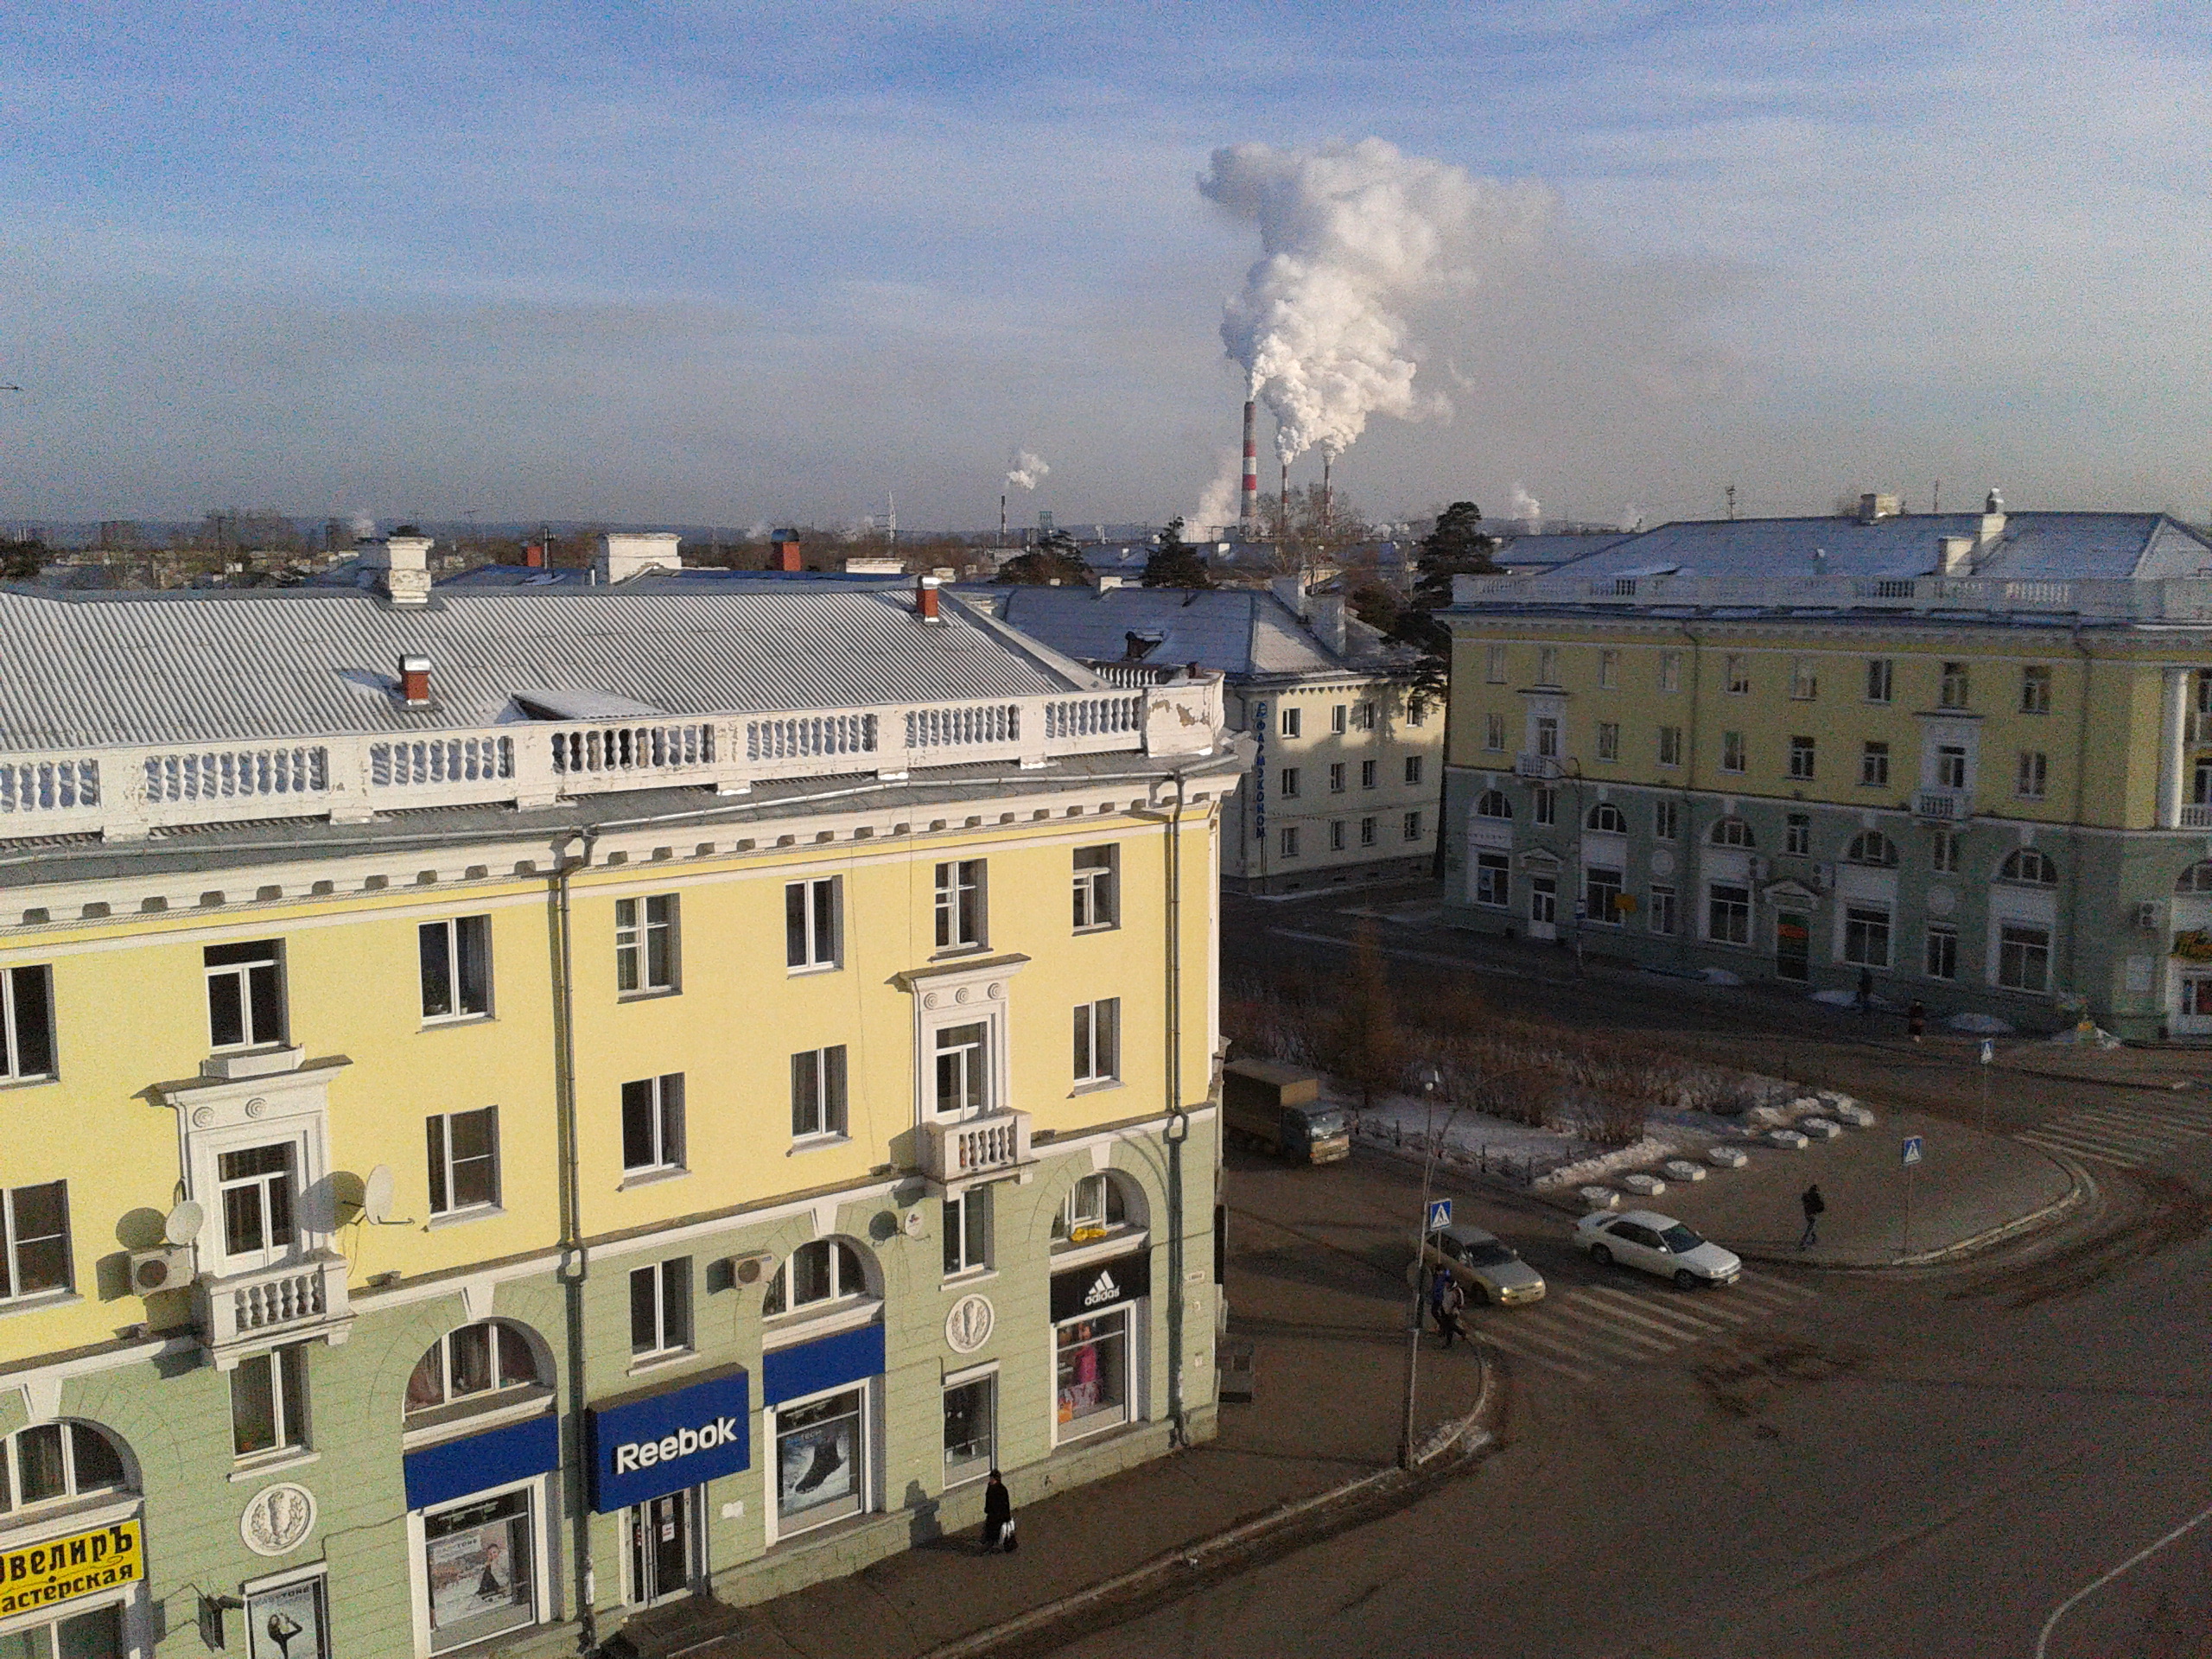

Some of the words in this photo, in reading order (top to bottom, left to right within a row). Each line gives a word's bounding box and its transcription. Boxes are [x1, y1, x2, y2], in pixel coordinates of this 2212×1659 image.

[1084, 1285, 1121, 1306] adidas
[617, 1417, 738, 1475] Reebok
[0, 1564, 133, 1613] астерская
